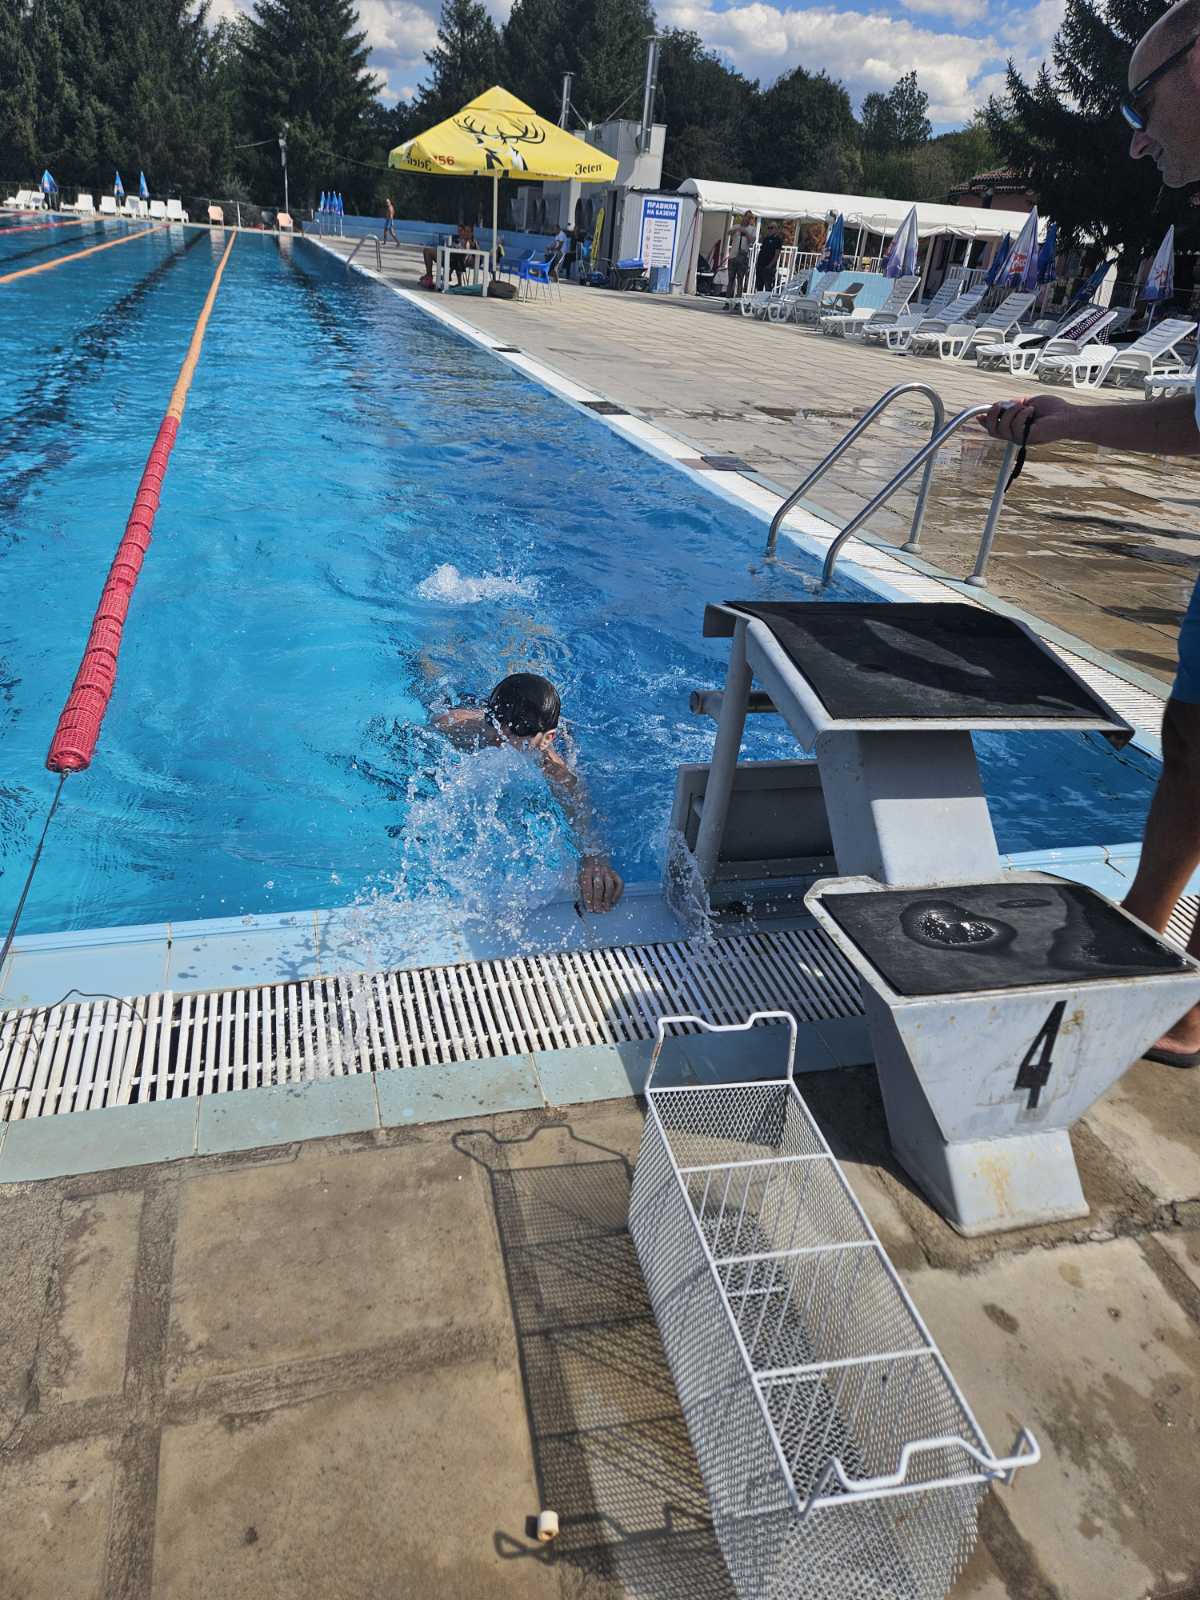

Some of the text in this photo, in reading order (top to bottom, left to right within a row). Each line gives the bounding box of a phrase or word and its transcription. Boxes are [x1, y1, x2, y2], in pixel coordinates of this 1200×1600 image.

[575, 163, 602, 175] Jelen
[647, 202, 676, 210] ПРАВИЛА
[1013, 1000, 1068, 1109] 4
